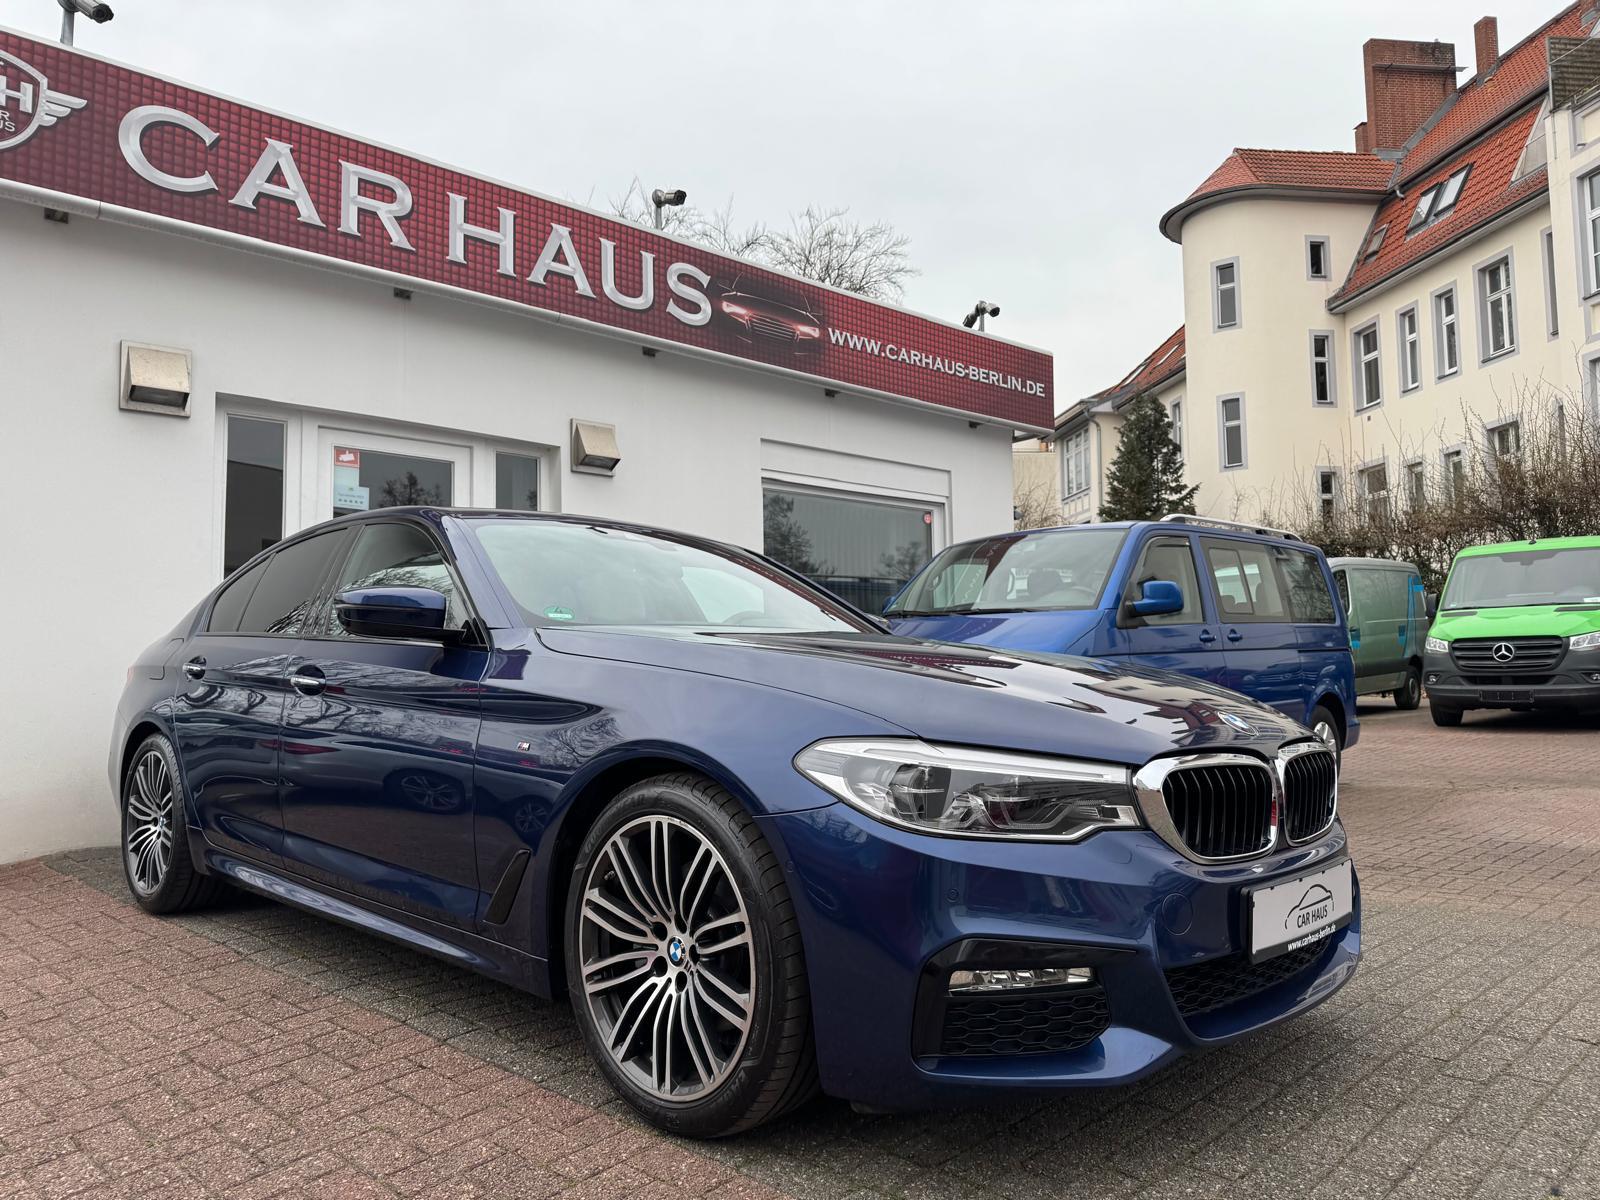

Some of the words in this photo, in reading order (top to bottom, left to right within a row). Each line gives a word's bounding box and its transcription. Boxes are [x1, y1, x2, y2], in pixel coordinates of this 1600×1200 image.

[118, 104, 416, 251] CAR
[447, 191, 713, 326] HAUS
[828, 327, 1046, 398] WWW.CARHAUS-BERLIN.DE
[1287, 923, 1336, 951] www.carhaus-berlin.de
[1297, 912, 1311, 928] CAR
[1312, 904, 1328, 923] HAUS
